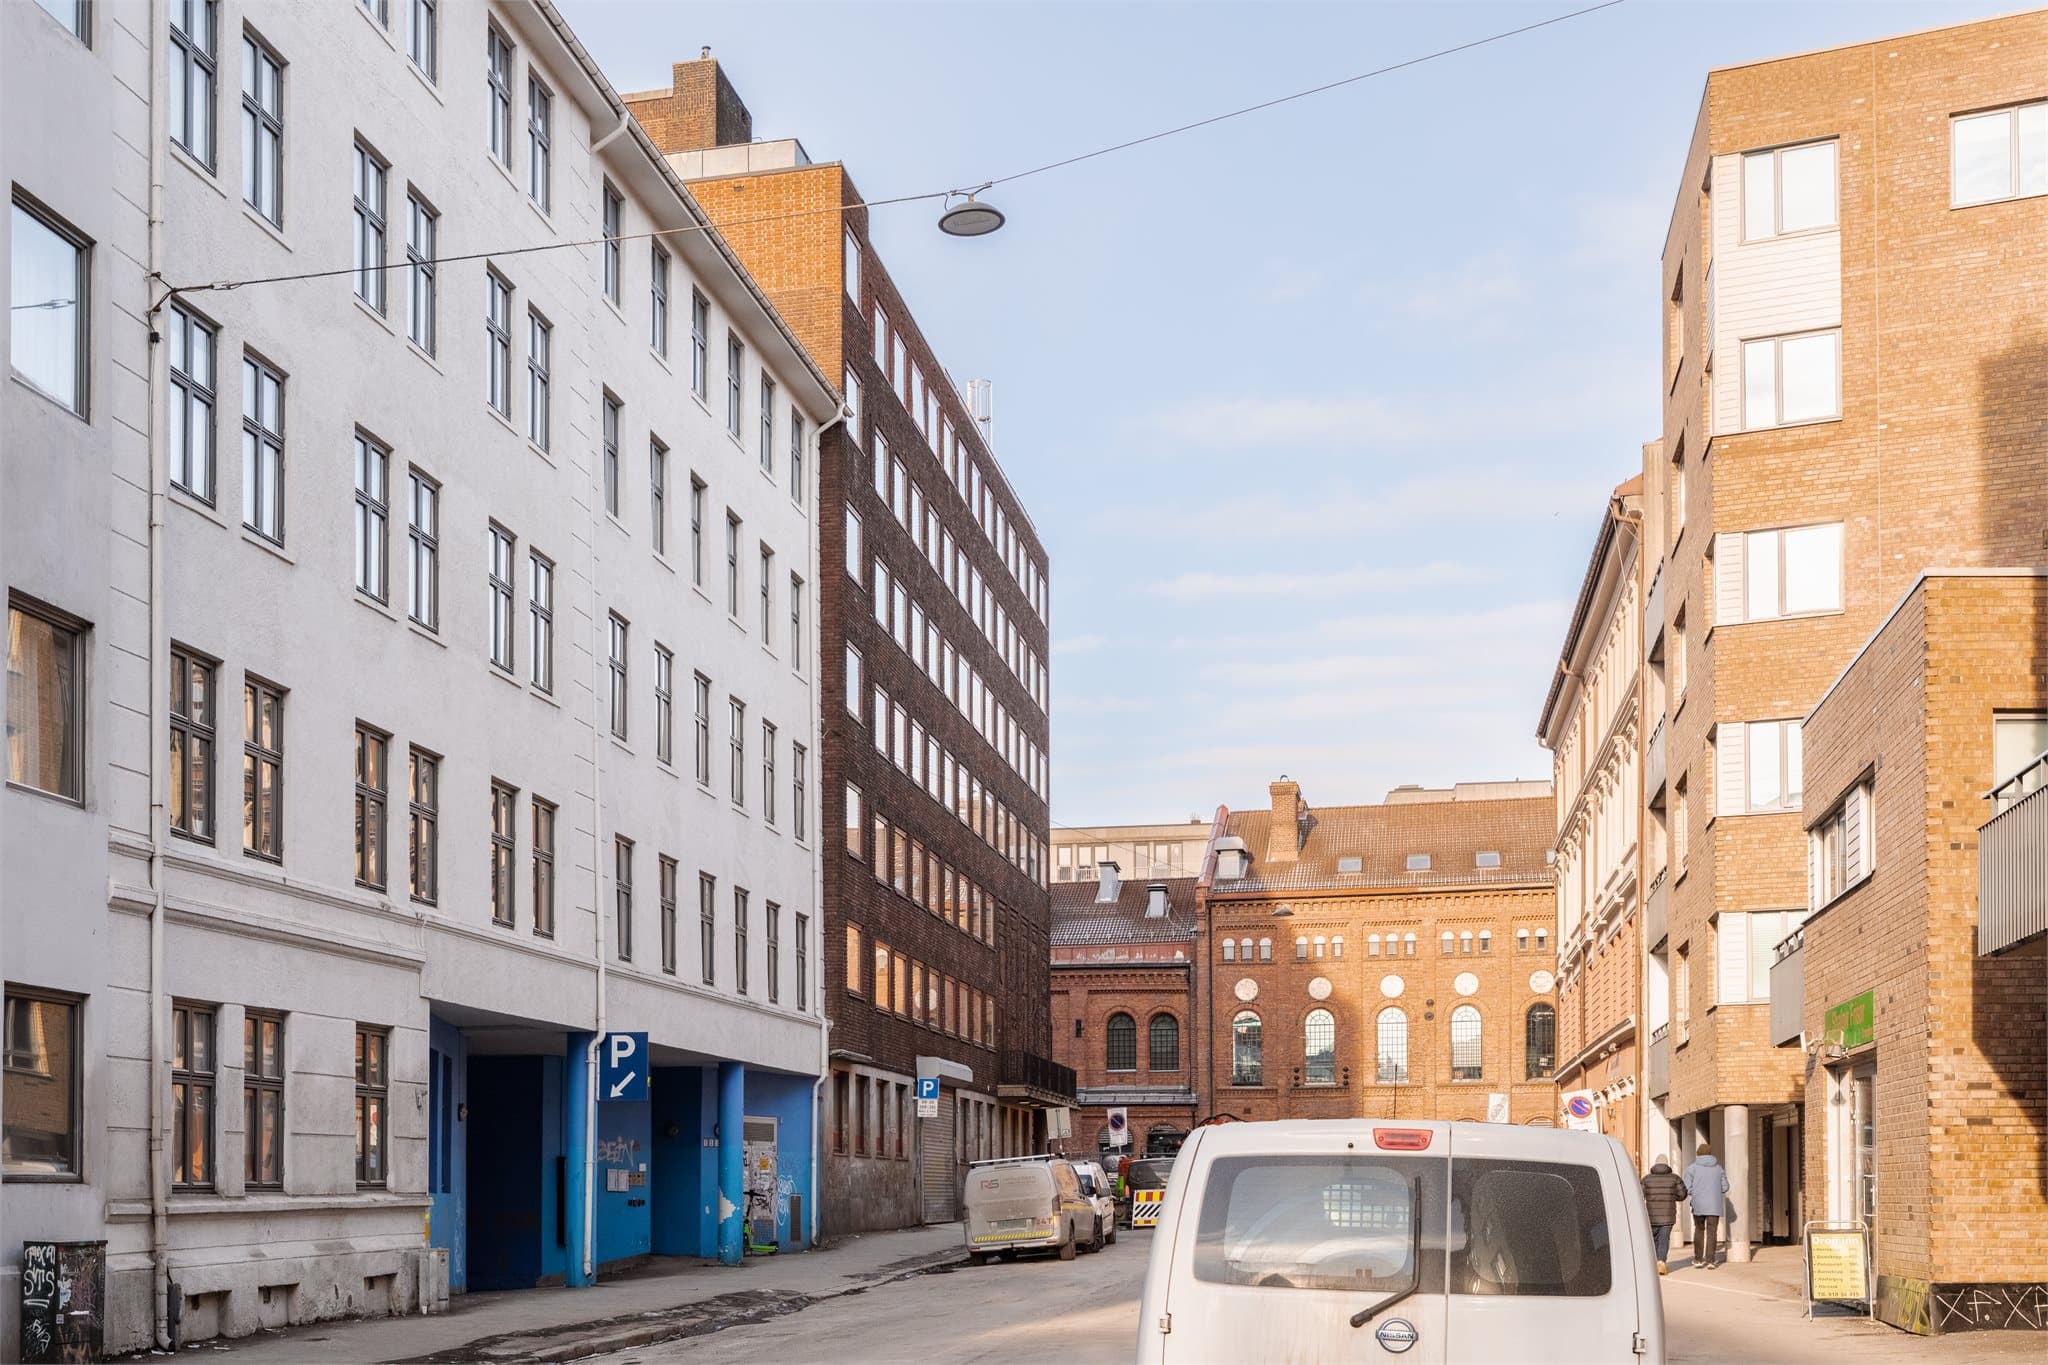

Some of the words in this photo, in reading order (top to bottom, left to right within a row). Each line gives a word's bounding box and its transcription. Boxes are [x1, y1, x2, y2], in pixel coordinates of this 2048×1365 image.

[611, 1034, 636, 1068] P
[923, 1080, 934, 1097] P
[1380, 1331, 1415, 1339] NISSAN
